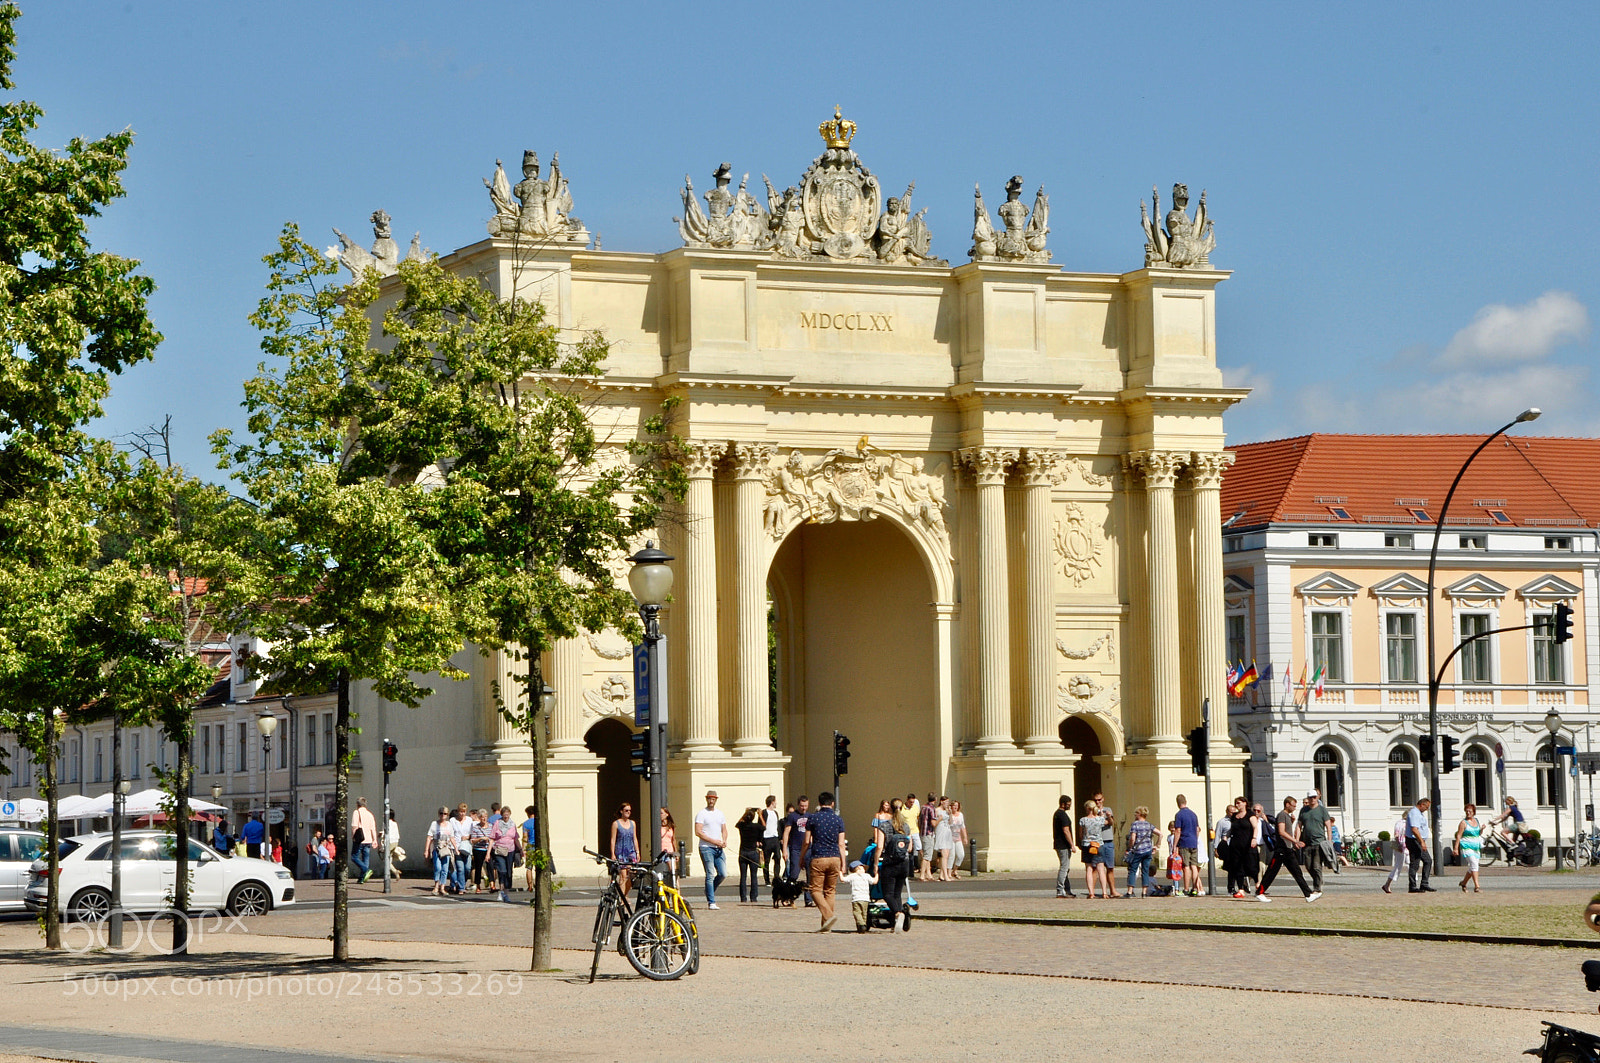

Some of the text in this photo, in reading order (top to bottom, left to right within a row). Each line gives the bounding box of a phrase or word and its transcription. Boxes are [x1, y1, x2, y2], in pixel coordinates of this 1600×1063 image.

[800, 311, 893, 332] MDCCLXX
[638, 656, 649, 690] P
[1398, 712, 1420, 721] HOTEL
[1480, 712, 1494, 721] TOR
